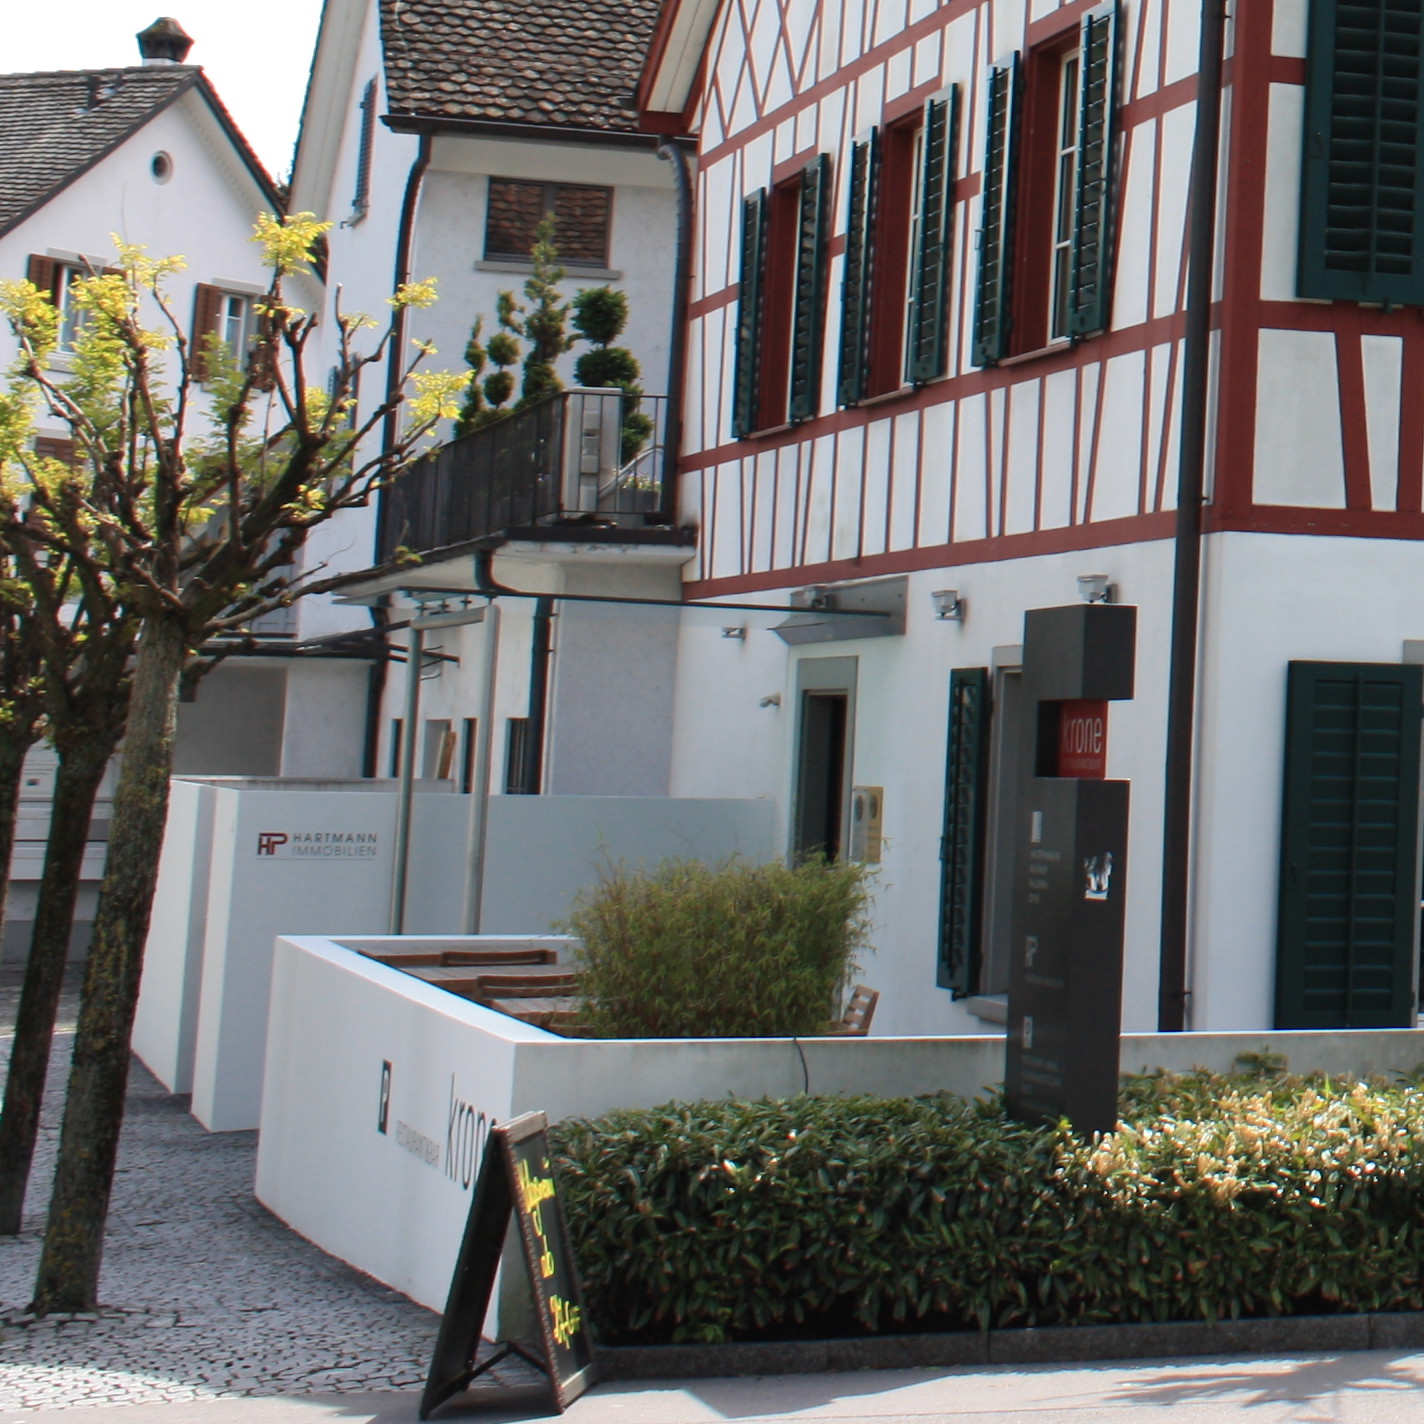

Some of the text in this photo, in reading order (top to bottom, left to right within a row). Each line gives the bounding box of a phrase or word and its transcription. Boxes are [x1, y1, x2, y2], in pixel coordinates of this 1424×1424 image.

[1063, 709, 1102, 753] krone
[291, 845, 376, 856] IMMOBILIEN
[293, 832, 377, 843] HARTMANN
[445, 1072, 496, 1191] kron
